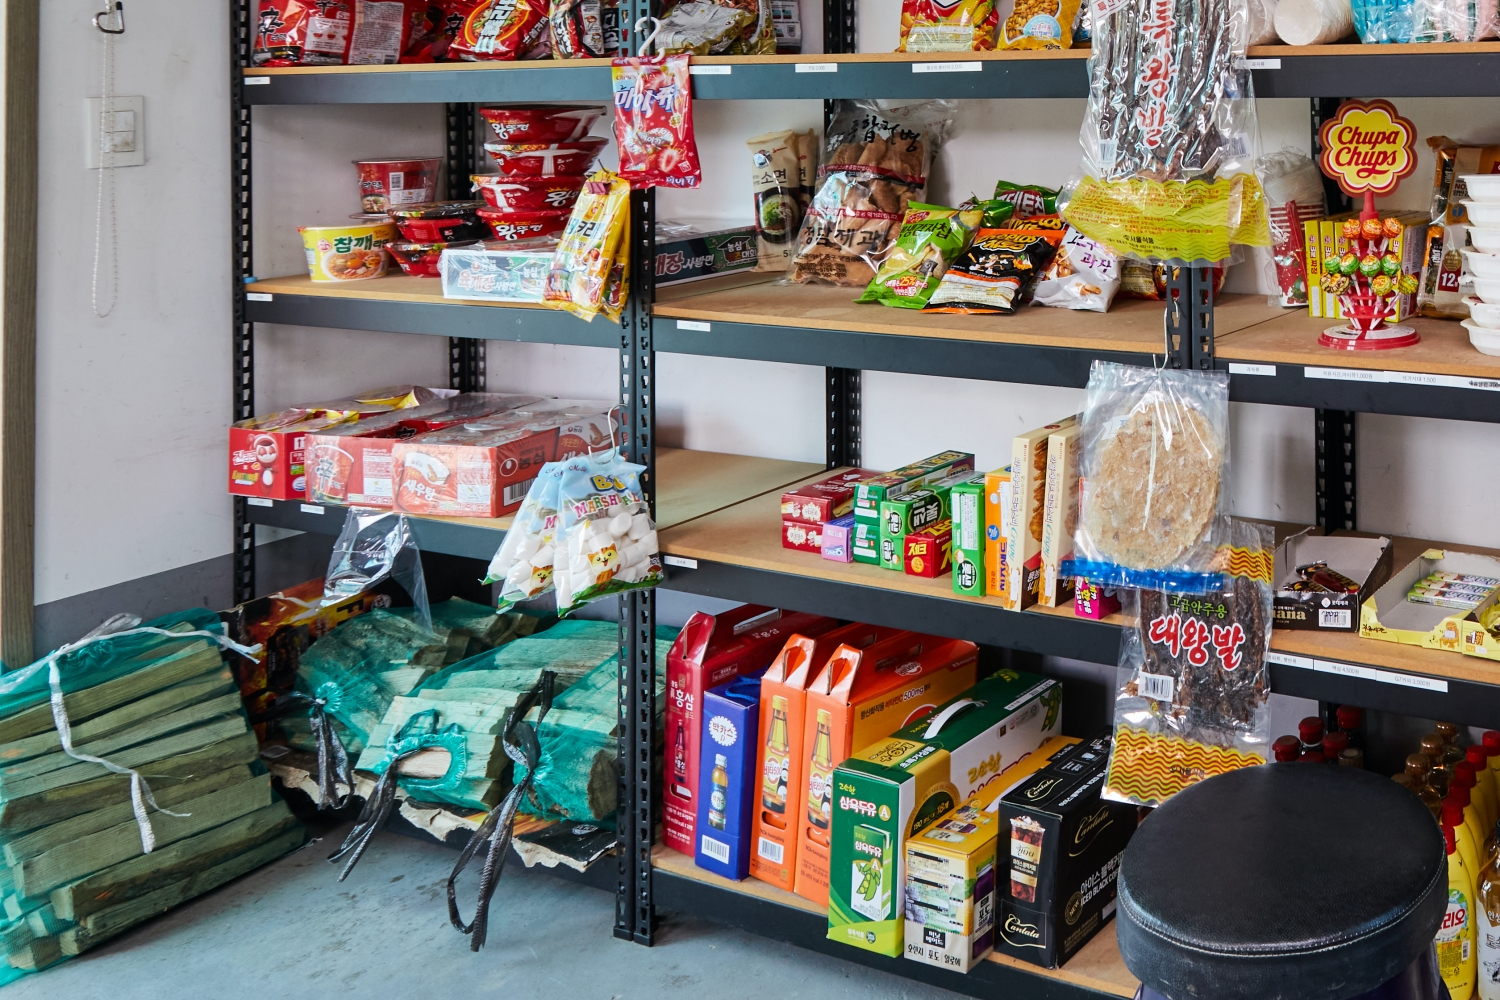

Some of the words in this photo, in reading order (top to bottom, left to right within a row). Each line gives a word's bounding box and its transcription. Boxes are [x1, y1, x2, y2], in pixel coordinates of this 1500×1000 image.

[491, 121, 530, 140] 왕뚜껑
[1337, 126, 1400, 150] Chupa
[1335, 147, 1398, 179] Chups
[760, 168, 788, 186] 소면
[495, 223, 544, 241] 왕뚜껑
[334, 235, 373, 254] 참깨
[458, 271, 495, 293] 육개장
[900, 275, 917, 287] 25%
[518, 453, 545, 470] 농심
[404, 479, 437, 501] 새우탕
[1008, 527, 1020, 561] Crispy
[1043, 524, 1056, 558] Crispy
[1170, 594, 1229, 620] 고급안주용
[1148, 613, 1246, 672] 대왕발
[1342, 667, 1360, 675] 4,500원
[676, 690, 695, 711] 홍삼
[903, 685, 924, 702] 500mg
[712, 721, 734, 738] 박카스
[967, 752, 1003, 785] 고소한
[839, 795, 878, 818] 삼육두유
[855, 840, 883, 858] 삼육두유
[1080, 872, 1102, 894] 아이스
[1080, 890, 1093, 908] ICED
[1092, 878, 1109, 899] BLACK
[1068, 899, 1081, 918] NEW
[928, 930, 941, 939] 미닛
[1004, 913, 1040, 939] Cantata
[907, 945, 924, 956] 오렌지
[928, 949, 940, 962] 포도
